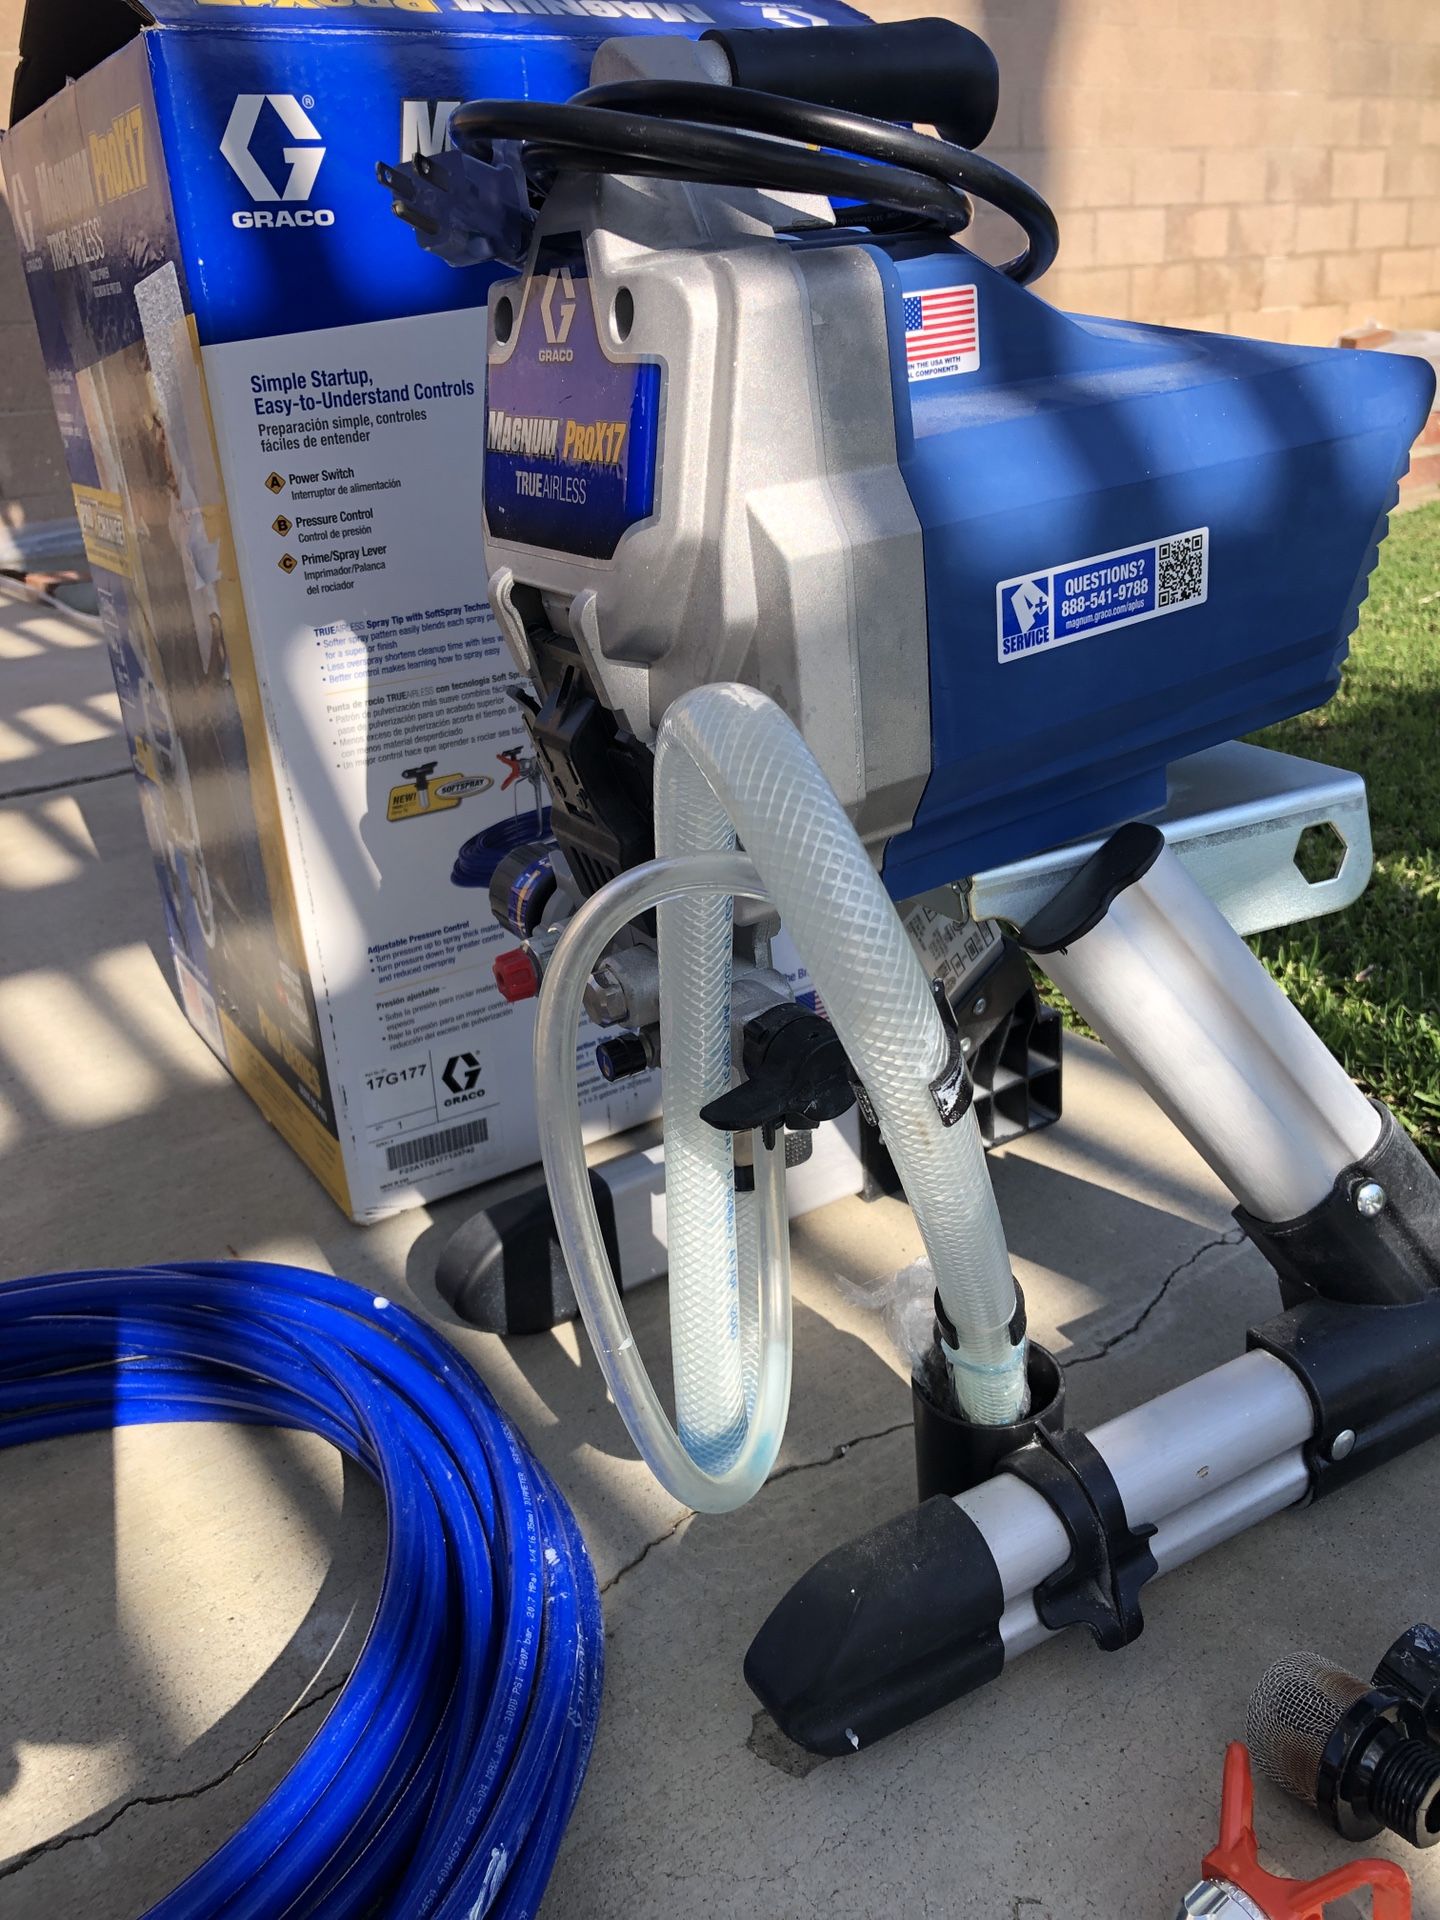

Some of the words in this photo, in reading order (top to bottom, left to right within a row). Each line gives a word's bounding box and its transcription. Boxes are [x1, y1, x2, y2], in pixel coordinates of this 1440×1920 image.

[232, 208, 335, 230] GRACO
[538, 350, 573, 362] GRACO
[917, 361, 928, 369] THE
[944, 356, 961, 364] WITH
[250, 373, 307, 395] Simple
[310, 368, 374, 388] Startup,
[916, 365, 959, 377] COMPONENTS
[254, 385, 410, 417] Easy-to-Understand
[413, 379, 475, 400] Controls
[258, 417, 330, 438] Preparación
[332, 414, 374, 431] simple,
[376, 409, 427, 425] controles
[487, 411, 559, 456] MAGNUM
[260, 435, 300, 453] fáciles
[303, 435, 318, 449] de
[320, 430, 371, 447] entender
[270, 476, 281, 489] A
[288, 472, 320, 485] Power
[322, 468, 355, 481] Switch
[515, 471, 587, 505] TRUEAIRLESS
[291, 486, 336, 501] Interruptor
[338, 483, 348, 495] de
[350, 478, 401, 494] alimentación
[277, 519, 288, 531] B
[295, 513, 338, 528] Pressure
[340, 508, 374, 522] Control
[298, 529, 328, 543] Control
[330, 527, 340, 539] de
[342, 525, 372, 539] presión
[283, 557, 293, 569] C
[301, 548, 360, 566] Prime/Spray
[361, 544, 387, 557] Lever
[304, 560, 386, 582] Imprimador/Palanca
[1065, 559, 1145, 596] QUESTIONS?
[306, 584, 320, 596] del
[321, 580, 354, 593] rociador
[1061, 578, 1148, 617] 888-541-9788
[367, 618, 389, 629] Spray
[391, 615, 404, 626] Tip
[405, 612, 423, 622] with
[425, 607, 462, 620] SoftSpray
[1065, 599, 1145, 629] magnum.graco.com/aplus
[370, 629, 397, 641] pattern
[399, 625, 419, 636] easily
[421, 621, 445, 632] blends
[447, 618, 464, 628] each
[466, 615, 484, 626] spray
[377, 640, 398, 651] finish
[385, 650, 416, 661] shortens
[417, 644, 446, 656] cleanup
[447, 642, 464, 651] time
[465, 638, 480, 648] with
[481, 636, 496, 645] less
[1003, 626, 1050, 655] SERVICE
[381, 663, 406, 674] makes
[407, 658, 437, 670] learning
[438, 655, 453, 664] how
[464, 650, 482, 660] spray
[327, 703, 350, 713] Punta
[352, 700, 362, 708] de
[436, 685, 449, 693] con
[491, 673, 507, 683] Soft
[373, 701, 420, 718] pulverización
[439, 694, 459, 704] suave
[461, 688, 490, 700] combina
[418, 711, 434, 720] para
[446, 702, 476, 714] acabado
[476, 697, 504, 708] superior
[393, 727, 402, 736] de
[452, 714, 474, 724] acorta
[483, 708, 506, 719] tiempo
[378, 751, 403, 762] control
[404, 748, 422, 757] hace
[424, 744, 437, 754] que
[439, 738, 469, 751] aprender
[477, 732, 496, 742] rociar
[383, 737, 413, 749] material
[415, 728, 463, 743] desperdiciado
[442, 779, 484, 794] SOFTSPRAY
[393, 792, 417, 805] NEW!
[368, 938, 408, 955] Adjustable
[409, 930, 442, 943] Pressure
[443, 921, 470, 933] Control
[375, 954, 391, 963] Turn
[392, 945, 422, 959] pressure
[424, 942, 433, 951] up
[443, 934, 461, 946] spray
[462, 929, 479, 940] thick
[376, 964, 393, 974] Turn
[394, 955, 424, 970] pressure
[425, 949, 444, 960] down
[445, 946, 456, 954] for
[457, 940, 480, 952] greater
[482, 932, 505, 944] control
[378, 974, 392, 984] and
[393, 965, 422, 979] reduced
[423, 957, 456, 972] overspray
[376, 997, 404, 1010] Presión
[407, 987, 440, 1002] ajustable
[404, 1008, 411, 1016] la
[412, 1000, 438, 1015] presión
[439, 997, 454, 1007] para
[405, 1028, 412, 1036] la
[413, 1021, 438, 1035] presión
[439, 1016, 455, 1027] para
[466, 1007, 486, 1019] mayor
[390, 1036, 424, 1052] reducción
[425, 1032, 435, 1041] del
[461, 1021, 470, 1030] de
[366, 1064, 427, 1090] 17G177
[444, 1089, 486, 1107] GRACO
[517, 1472, 532, 1506] DIAMETER
[523, 1624, 536, 1646] bar,
[512, 1676, 525, 1695] PSI
[504, 1699, 518, 1726] 3000
